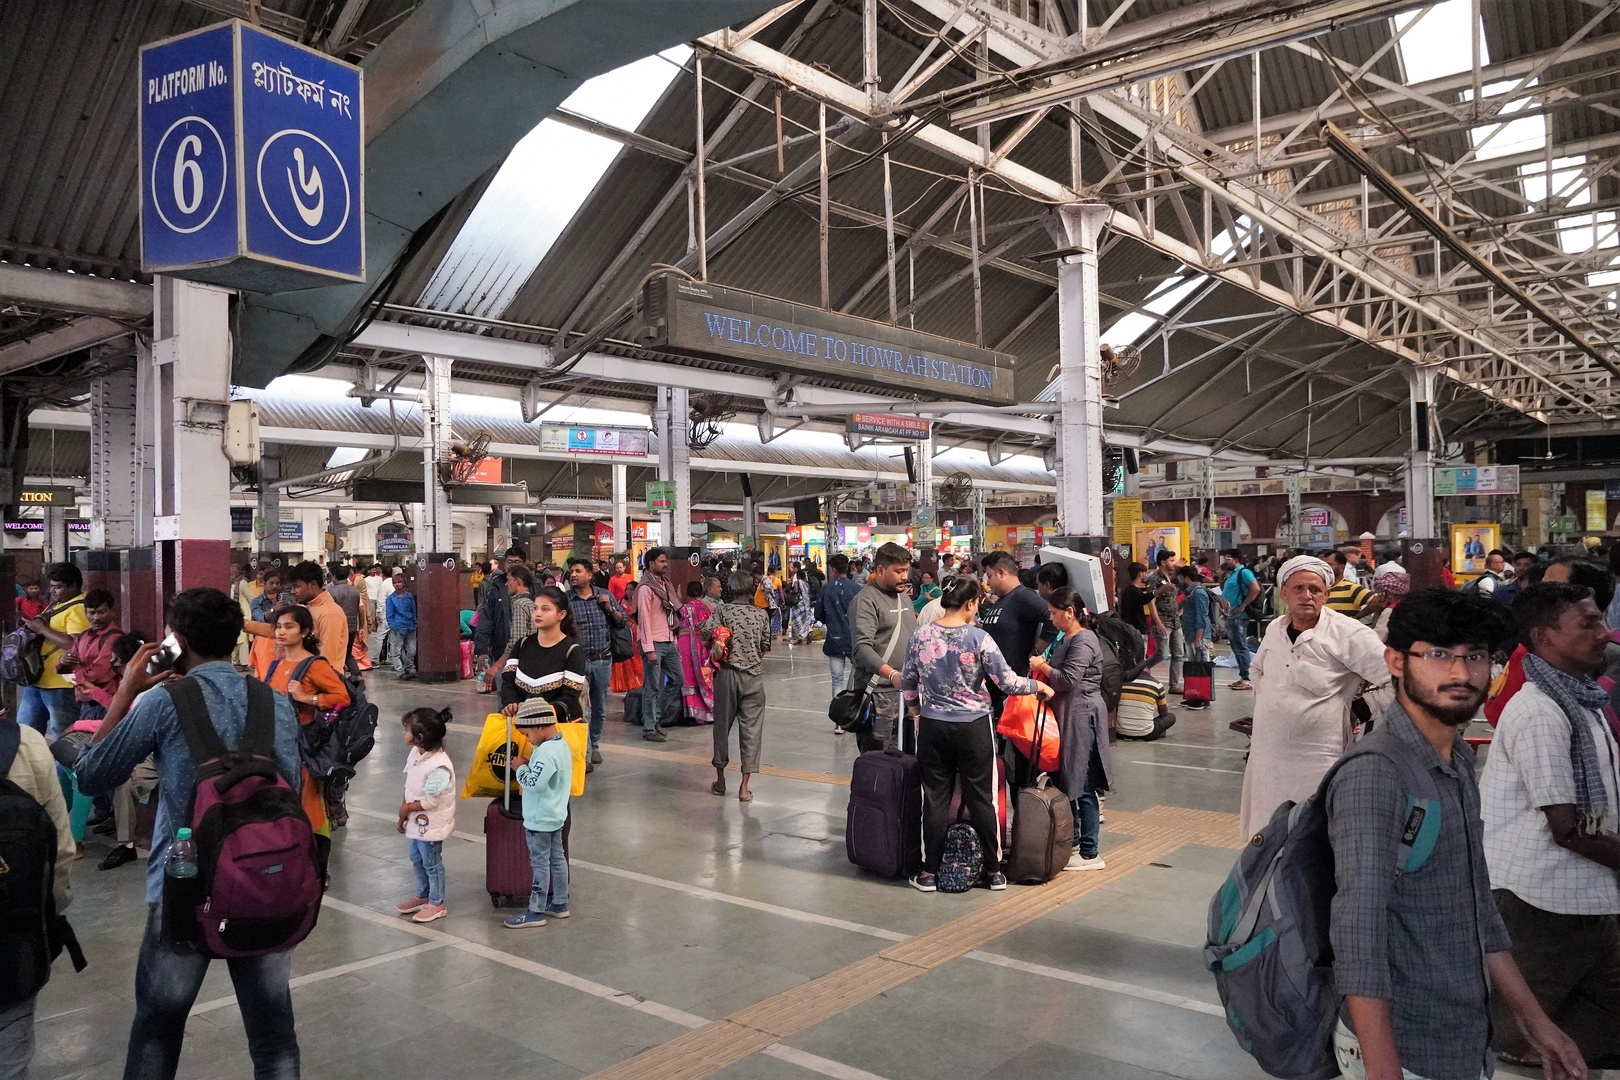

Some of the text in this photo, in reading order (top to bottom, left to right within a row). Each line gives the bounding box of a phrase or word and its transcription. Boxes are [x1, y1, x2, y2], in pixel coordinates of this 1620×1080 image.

[149, 60, 227, 104] PLATFORM No.
[251, 61, 352, 120] প্ল্যাটফর্ম নং
[173, 134, 204, 214] 6
[286, 147, 324, 227] ৬
[704, 312, 992, 389] WELCOME TO HOWRAH STATION
[857, 423, 875, 432] SAINIK
[861, 415, 886, 425] SERVICE
[886, 418, 900, 427] WITH
[905, 420, 921, 429] SMILE
